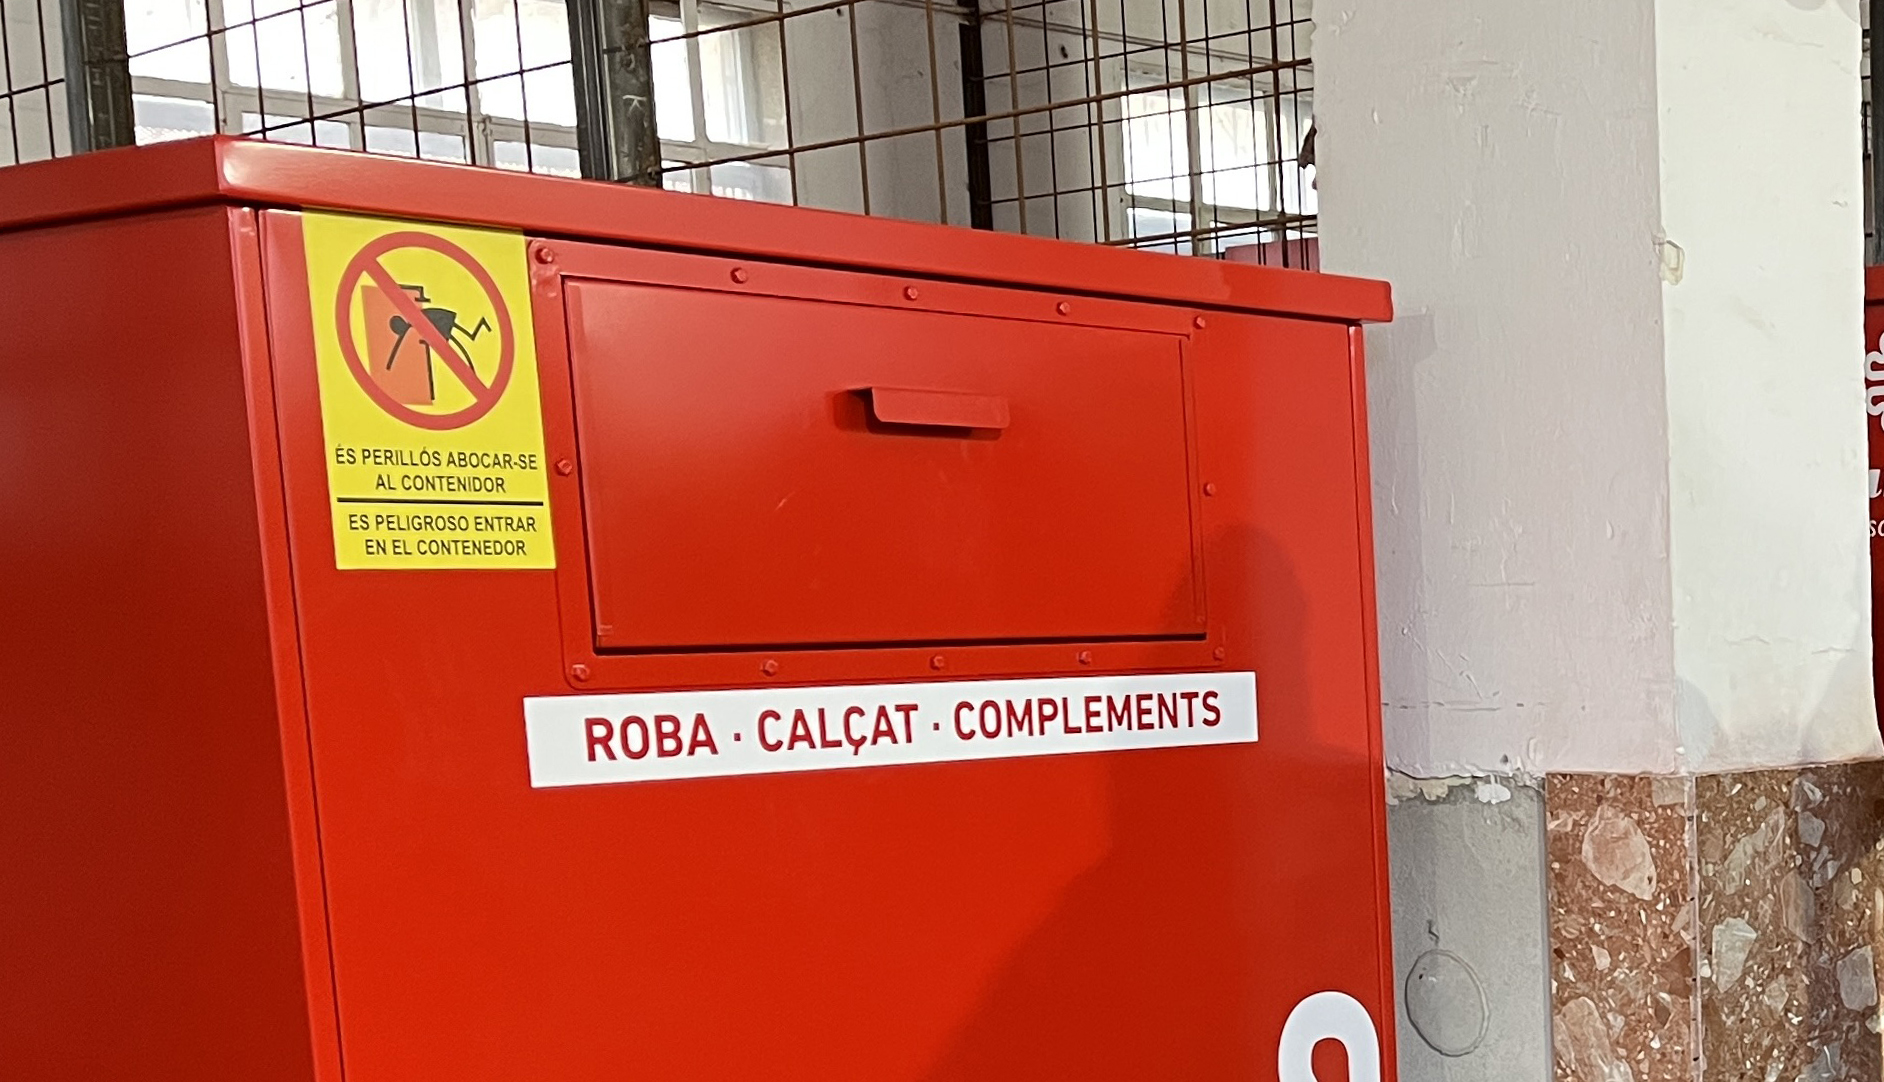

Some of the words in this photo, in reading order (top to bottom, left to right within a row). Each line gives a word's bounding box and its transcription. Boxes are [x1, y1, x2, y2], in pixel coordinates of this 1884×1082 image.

[362, 447, 442, 468] PERILLÓS
[446, 451, 538, 471] ABOCAR-SE
[375, 474, 397, 491] AL
[401, 475, 506, 493] CONTENIDOR
[348, 513, 370, 531] ES
[376, 514, 469, 532] PELIGROSO
[474, 516, 537, 533] ENTRAR
[365, 539, 387, 556] EN
[392, 539, 412, 556] EL
[417, 539, 527, 557] CONTENEDOR
[583, 713, 719, 762] ROBA
[757, 703, 919, 756] CALÇAT
[953, 689, 1222, 741] COMPLEMENTS
